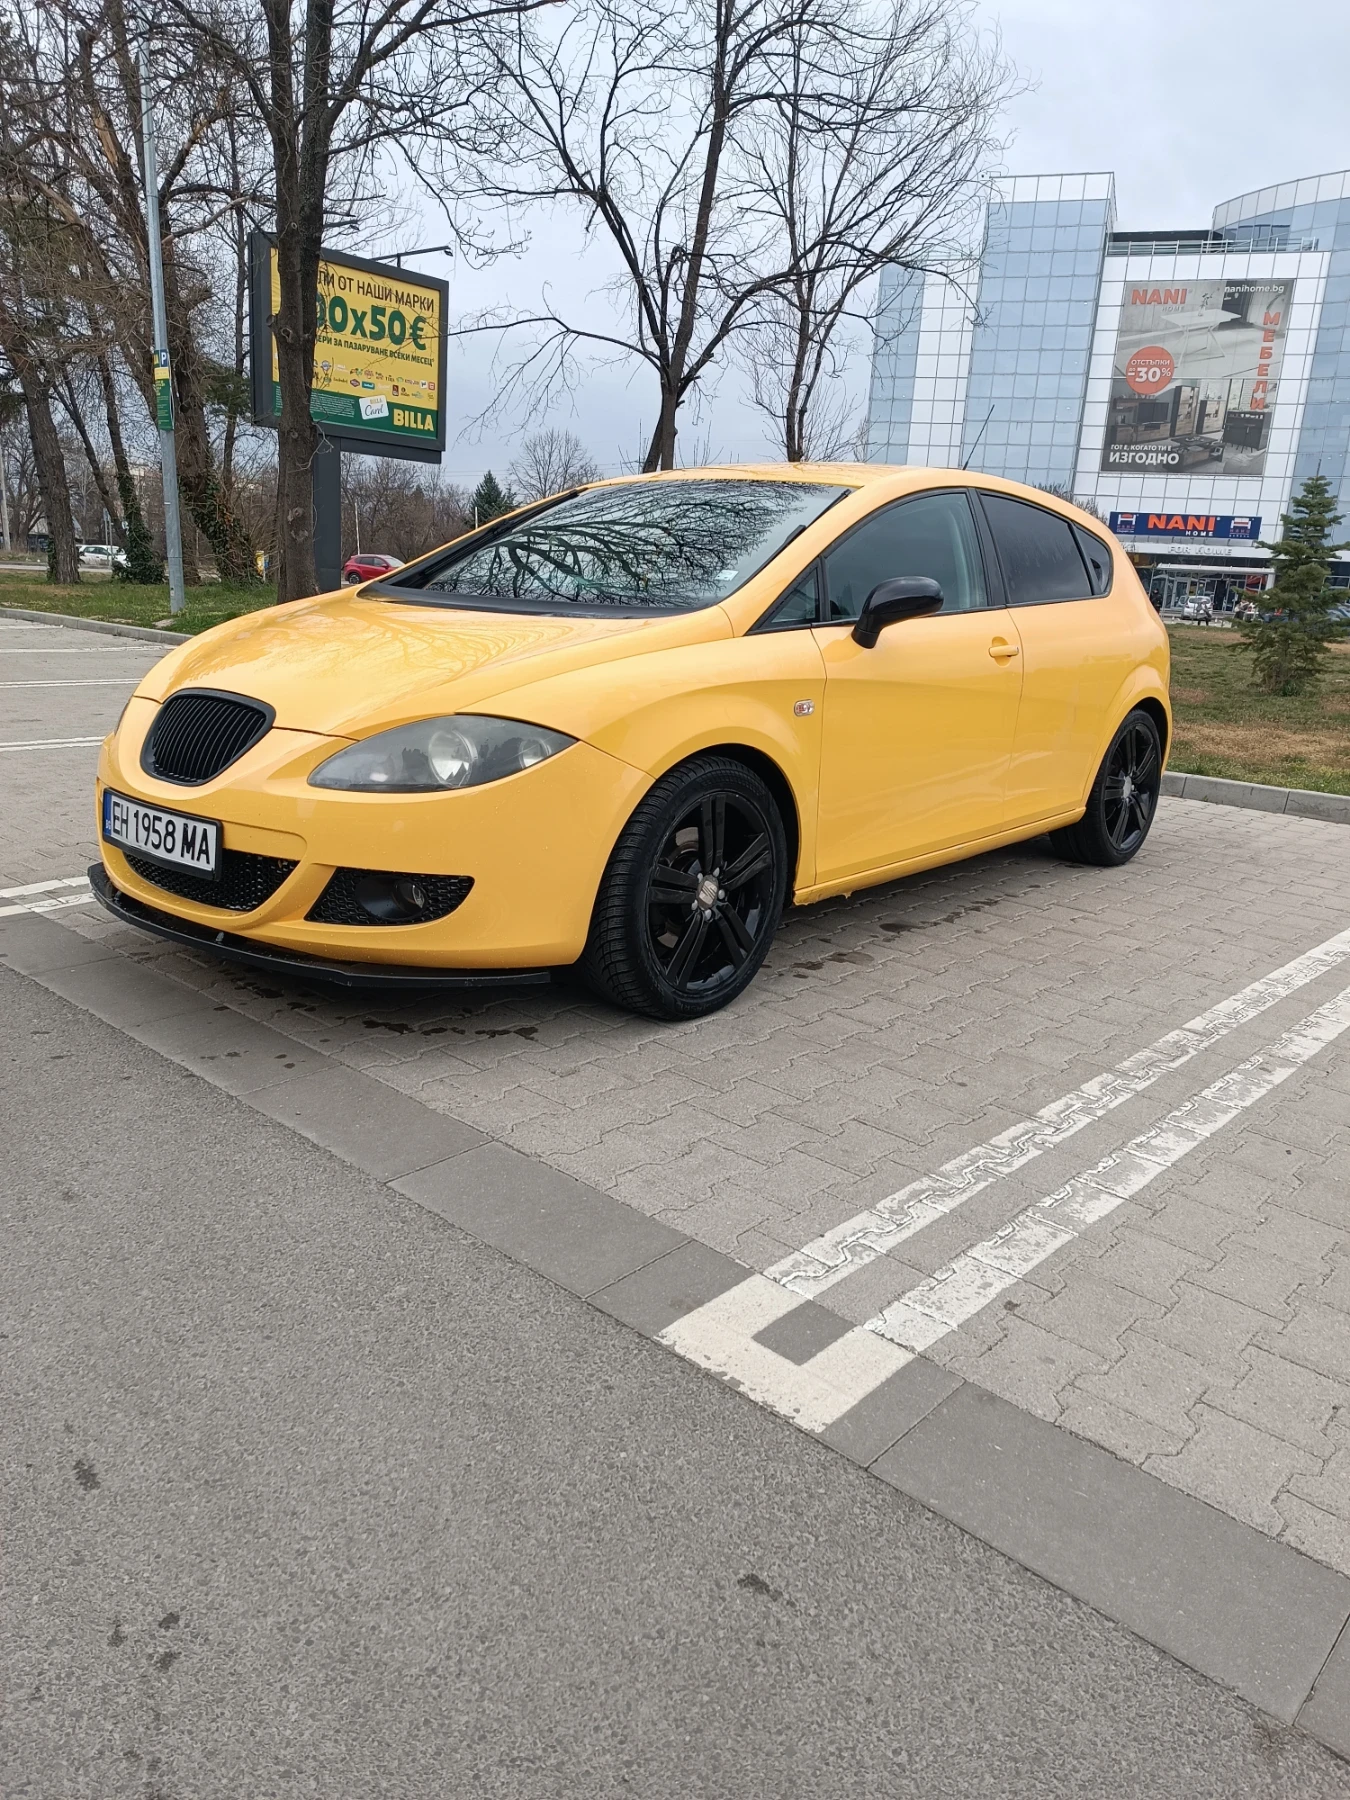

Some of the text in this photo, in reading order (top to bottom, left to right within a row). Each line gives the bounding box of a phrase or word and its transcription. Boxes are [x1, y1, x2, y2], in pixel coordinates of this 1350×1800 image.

[338, 275, 354, 293] ОТ
[357, 279, 393, 303] НАШИ
[395, 289, 434, 313] МАРКИ
[1131, 289, 1187, 305] NANI
[1224, 284, 1285, 294] nanihome.bg
[161, 352, 167, 365] P
[333, 338, 343, 348] ЗА
[344, 340, 388, 357] ПАЗАРУВАНЕ
[389, 350, 410, 362] ВСЕКИ
[1250, 311, 1281, 410] МЕБЕЛИ
[1128, 366, 1172, 383] -30%
[364, 404, 384, 417] Card
[393, 408, 434, 432] BILLA
[1109, 452, 1180, 466] ИЗГОДНО
[1147, 514, 1216, 531] NANI
[133, 809, 177, 854] 1958
[180, 822, 211, 865] MA
